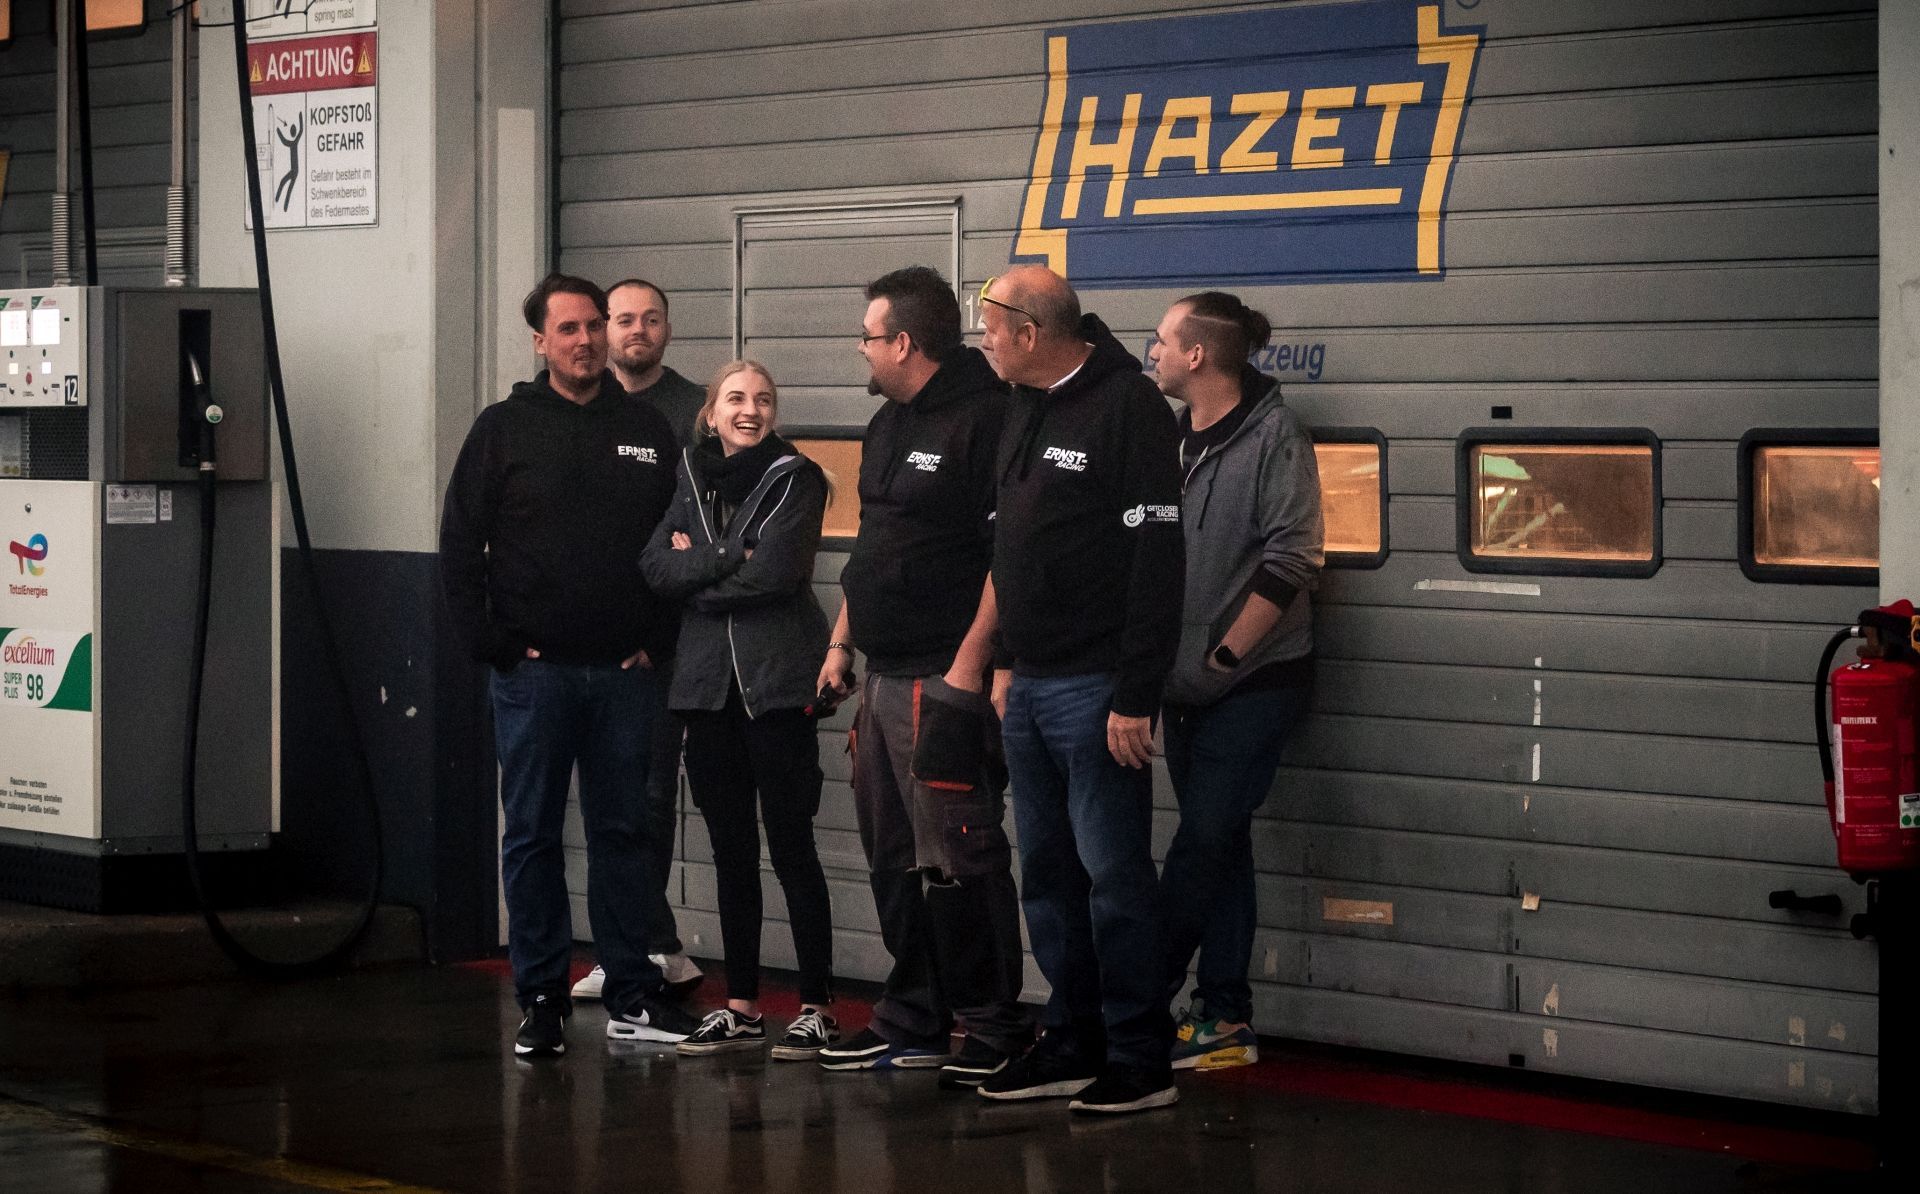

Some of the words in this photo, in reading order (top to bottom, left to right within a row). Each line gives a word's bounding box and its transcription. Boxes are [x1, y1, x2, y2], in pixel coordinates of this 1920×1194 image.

[314, 9, 336, 23] spring
[337, 7, 354, 18] mast
[266, 45, 354, 82] ACHTUNG
[310, 102, 372, 126] KOPFSTOß
[317, 131, 365, 152] GEFAHR
[1060, 81, 1425, 220] HAZET
[310, 169, 334, 182] Gefahr
[335, 167, 361, 181] besteht
[362, 169, 372, 180] im
[310, 186, 366, 201] Schwenkbereich
[310, 206, 324, 218] des
[325, 204, 370, 217] Federmastes
[65, 378, 78, 402] 12
[636, 455, 657, 464] RACING
[1042, 446, 1088, 465] ERNST-
[915, 463, 938, 472] RACING
[1054, 460, 1086, 472] RACING
[9, 584, 48, 598] TotalEnergies
[4, 641, 55, 666] excellium
[4, 672, 22, 684] SUPER
[4, 686, 18, 699] PLUS
[26, 673, 44, 701] 98
